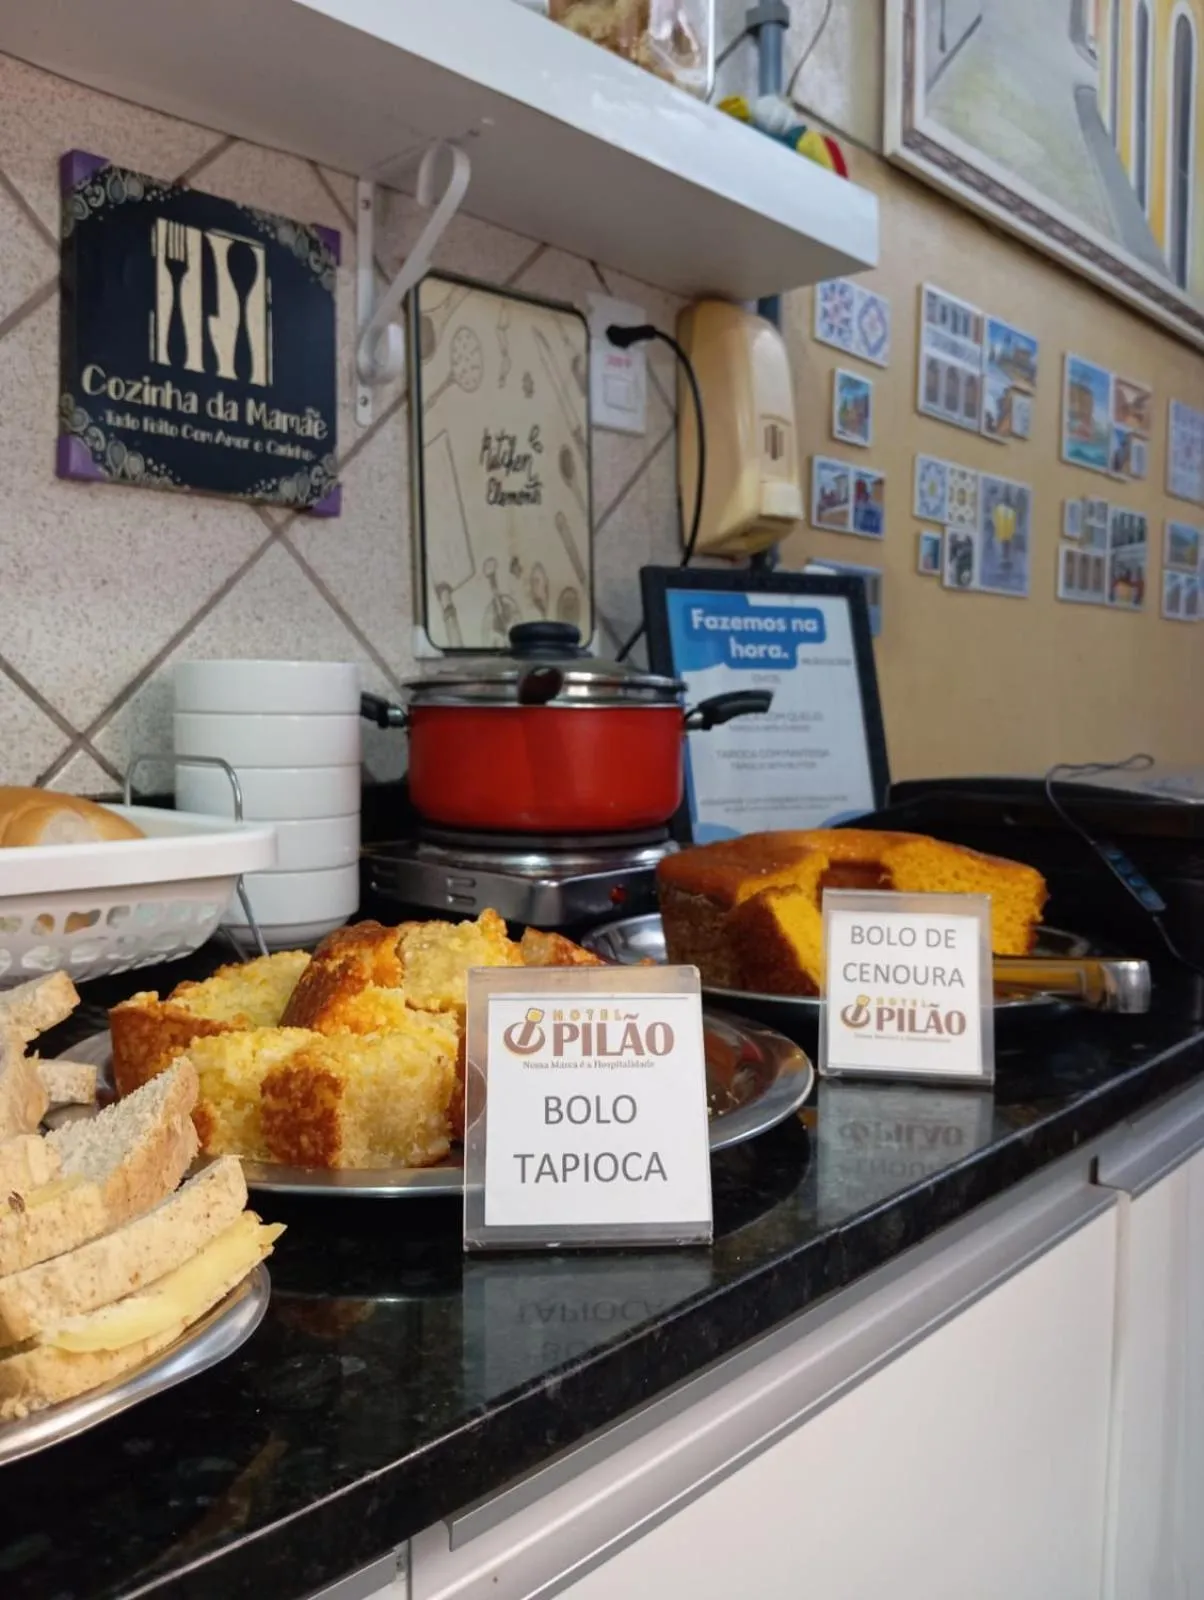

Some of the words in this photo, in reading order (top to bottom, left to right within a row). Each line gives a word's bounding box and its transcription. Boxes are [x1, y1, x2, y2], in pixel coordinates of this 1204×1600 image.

[81, 364, 198, 415] Cozinha
[206, 391, 239, 422] da
[246, 397, 328, 440] Mamãe
[142, 415, 179, 438] Feito
[691, 608, 788, 633] Fazemos
[792, 618, 818, 633] na
[729, 637, 789, 659] hora.
[850, 925, 917, 947] BOLO
[926, 928, 957, 949] DE
[842, 962, 966, 988] CENOURA
[553, 1009, 622, 1021] HOTEL
[876, 1003, 967, 1036] PILÃO
[553, 1013, 675, 1057] PILÃO
[544, 1094, 637, 1125] BOLO
[513, 1151, 668, 1184] TAPIOCA
